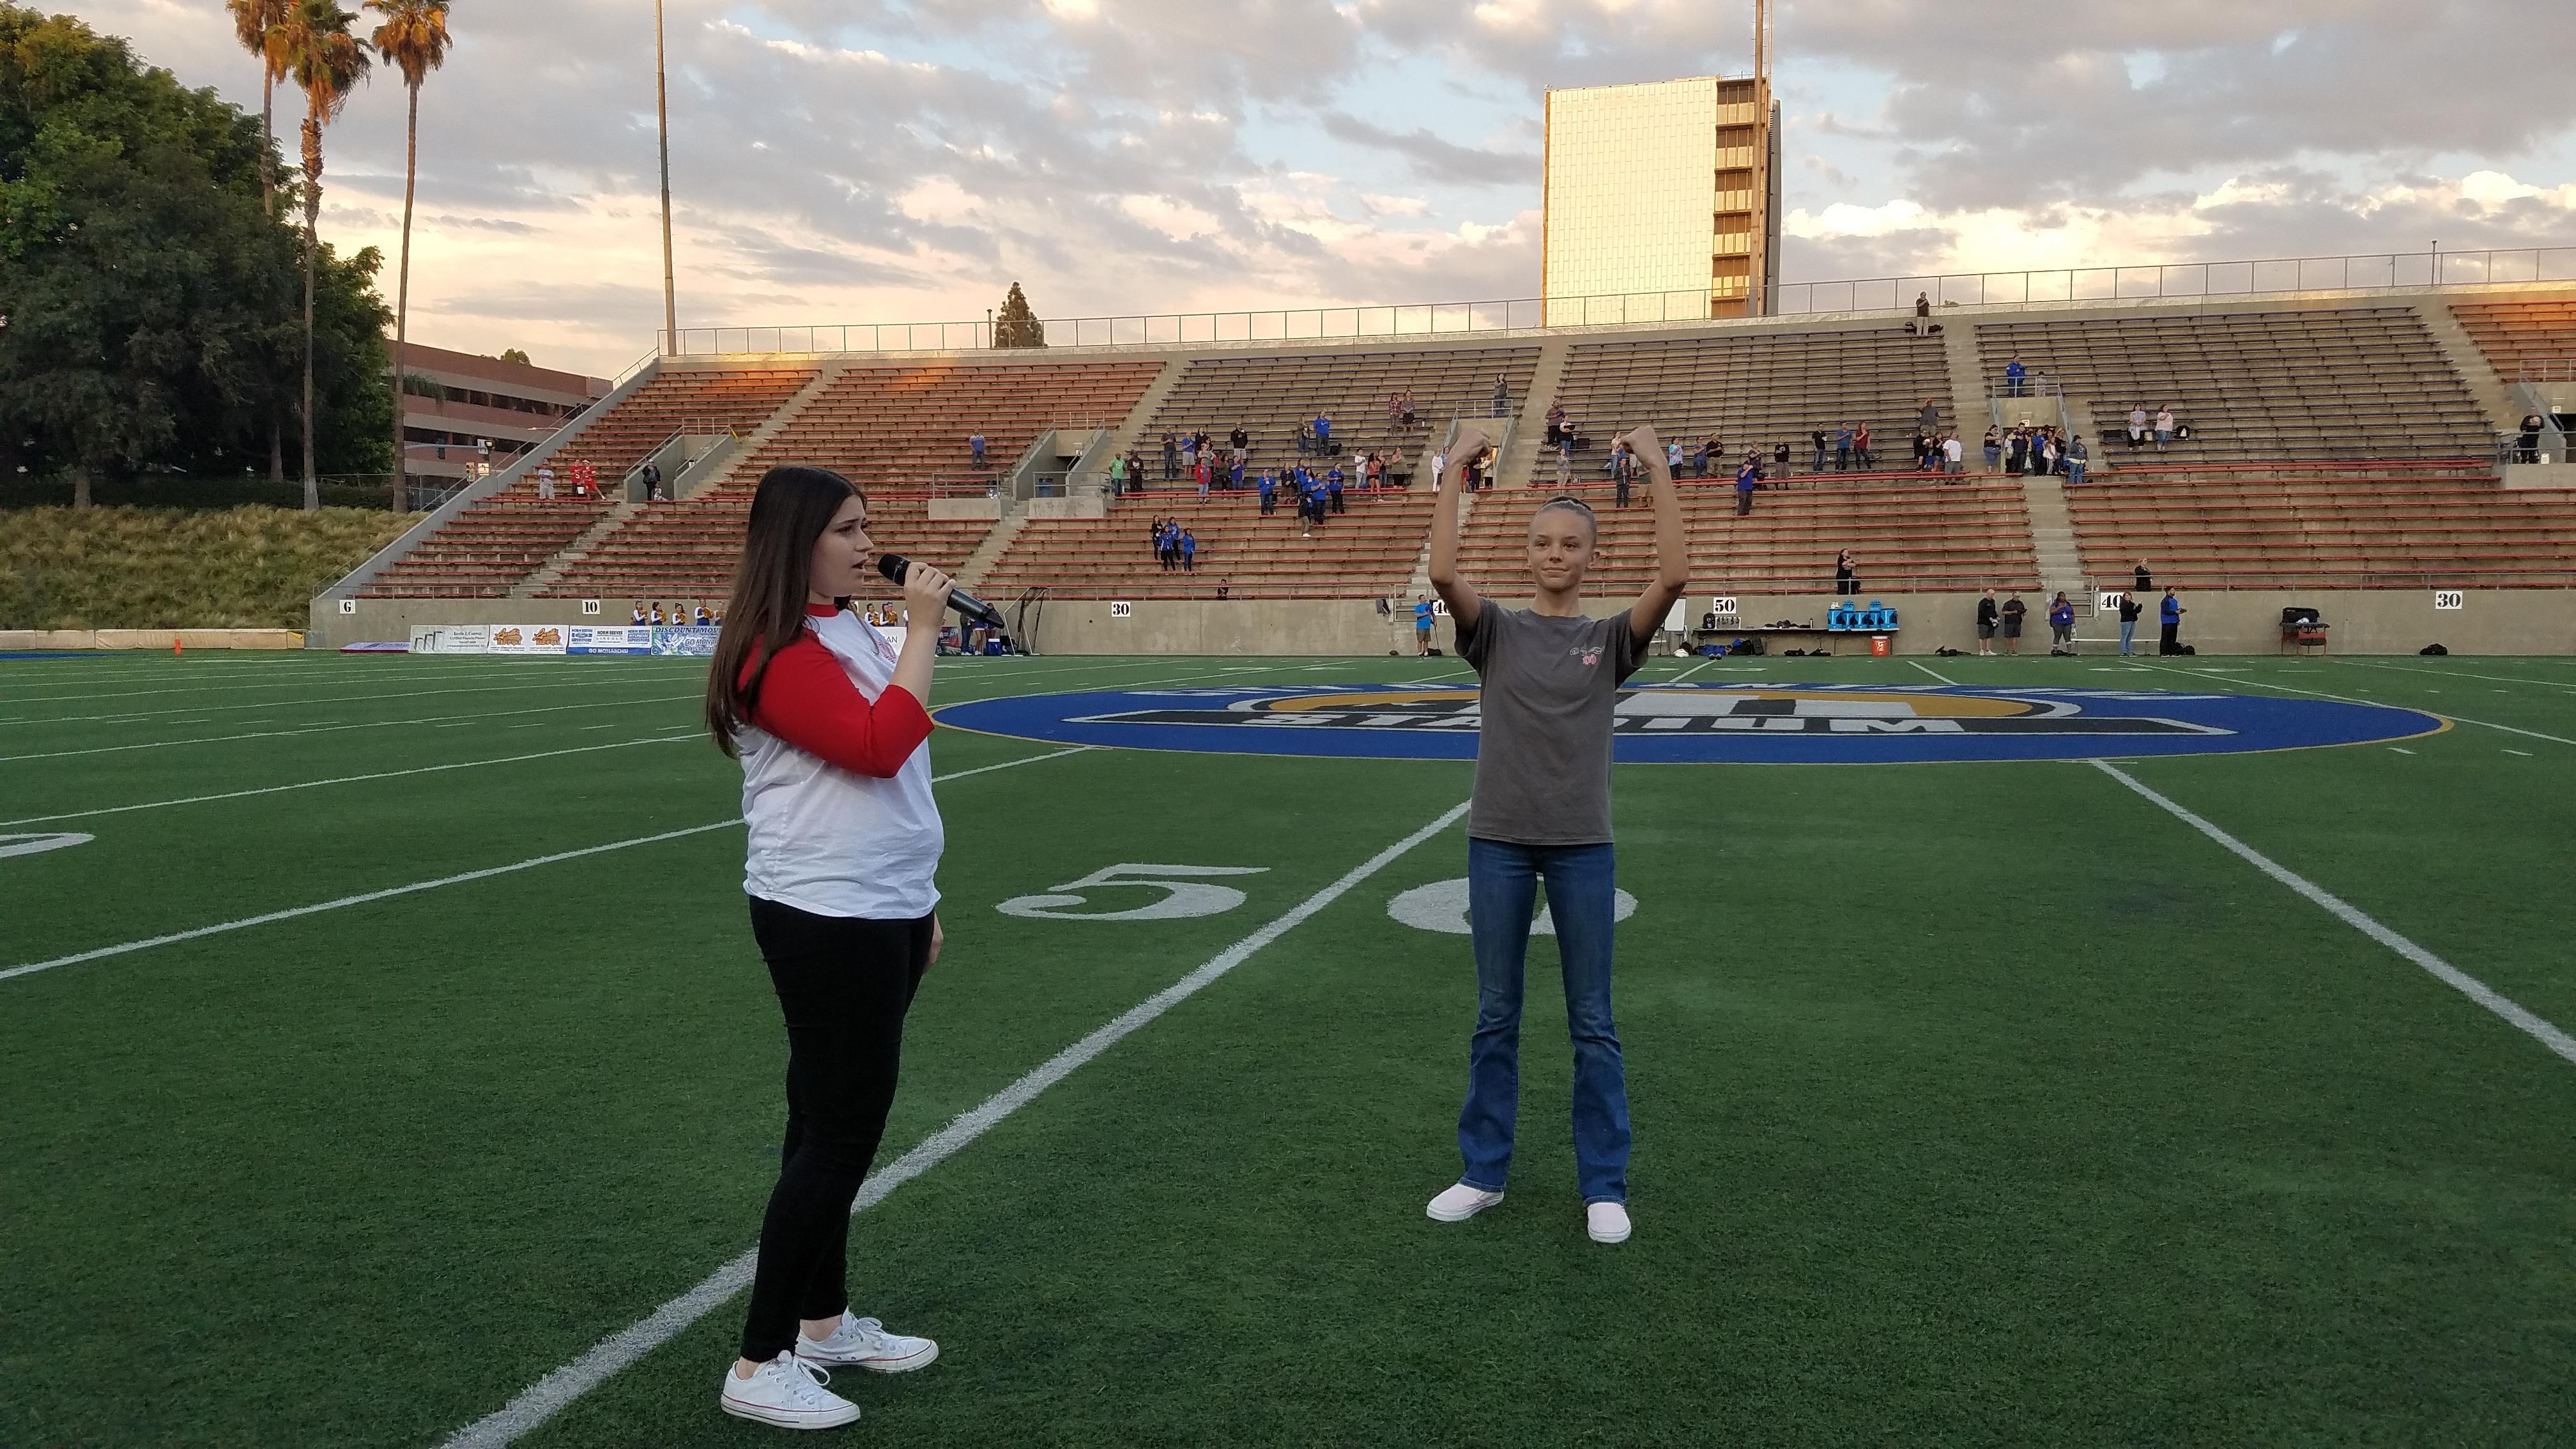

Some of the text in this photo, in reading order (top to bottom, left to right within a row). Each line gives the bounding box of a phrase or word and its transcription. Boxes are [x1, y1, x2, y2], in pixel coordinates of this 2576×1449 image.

[1715, 599, 1735, 612] 50
[2437, 593, 2461, 607] 30
[585, 601, 598, 613] 10
[1113, 603, 1130, 615] 30
[1242, 714, 1964, 732] STAIUM
